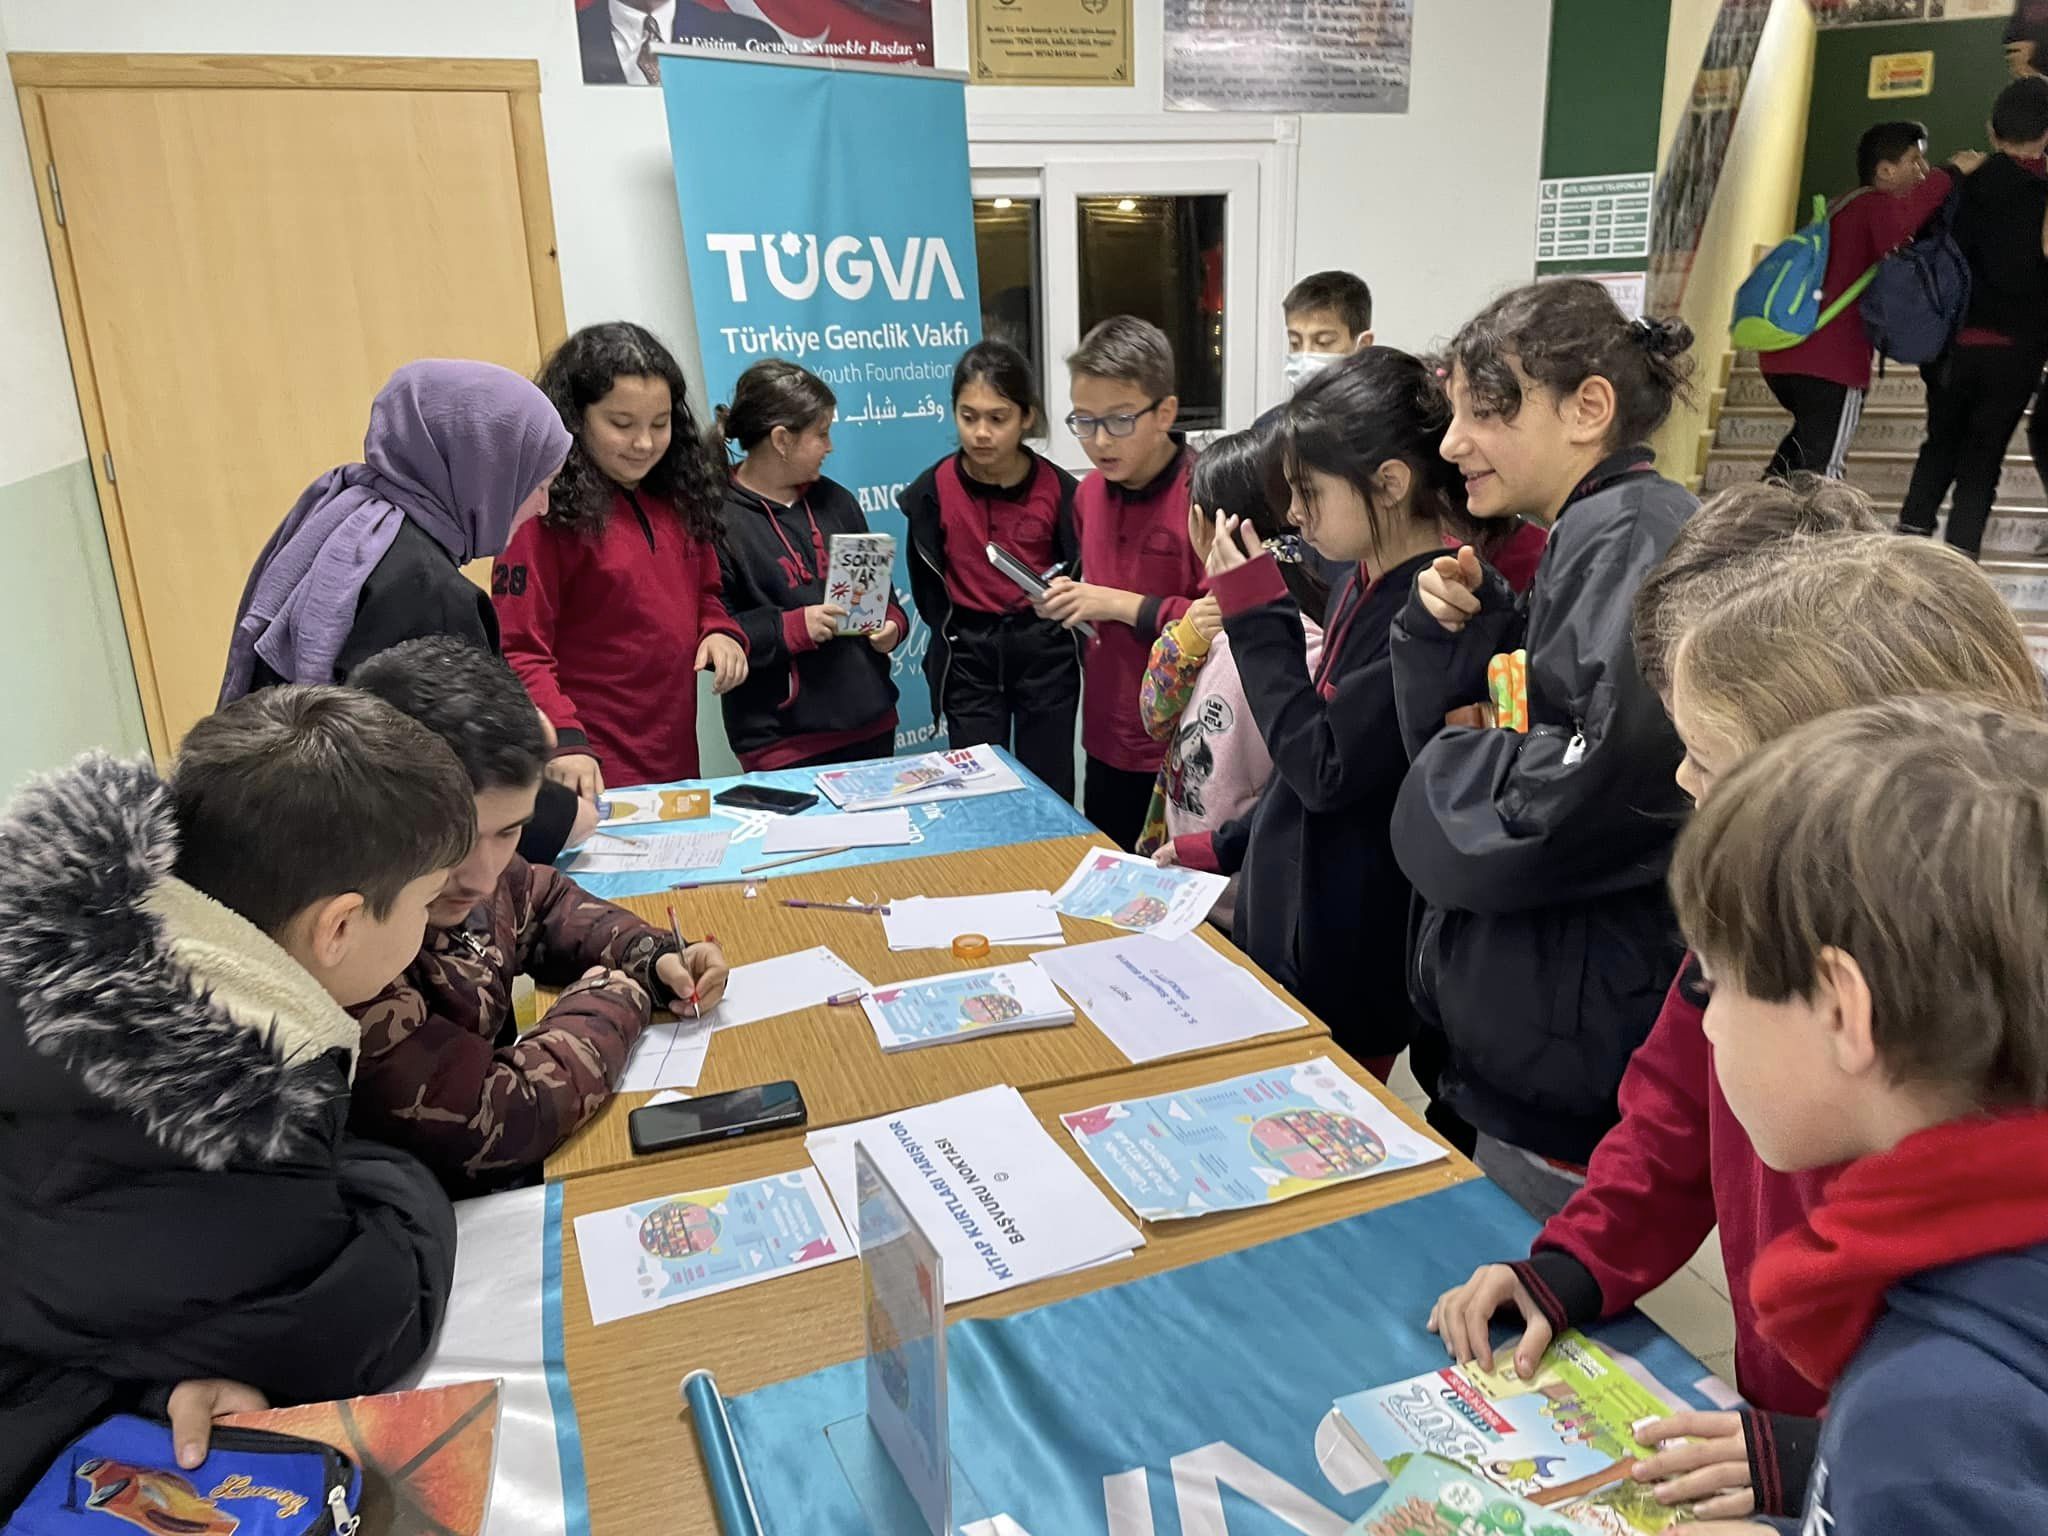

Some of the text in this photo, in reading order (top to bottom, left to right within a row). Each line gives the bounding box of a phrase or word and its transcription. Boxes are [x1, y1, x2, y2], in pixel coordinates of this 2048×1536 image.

[706, 231, 965, 302] TÜGVA
[720, 321, 969, 357] Türkiye Gençlik Vakfı
[813, 360, 953, 385] Youth Foundation
[889, 1120, 1014, 1281] KİTAP KURTLARI YARIŞIYOR
[934, 1137, 1026, 1245] BAŞVURU NOKTASI
